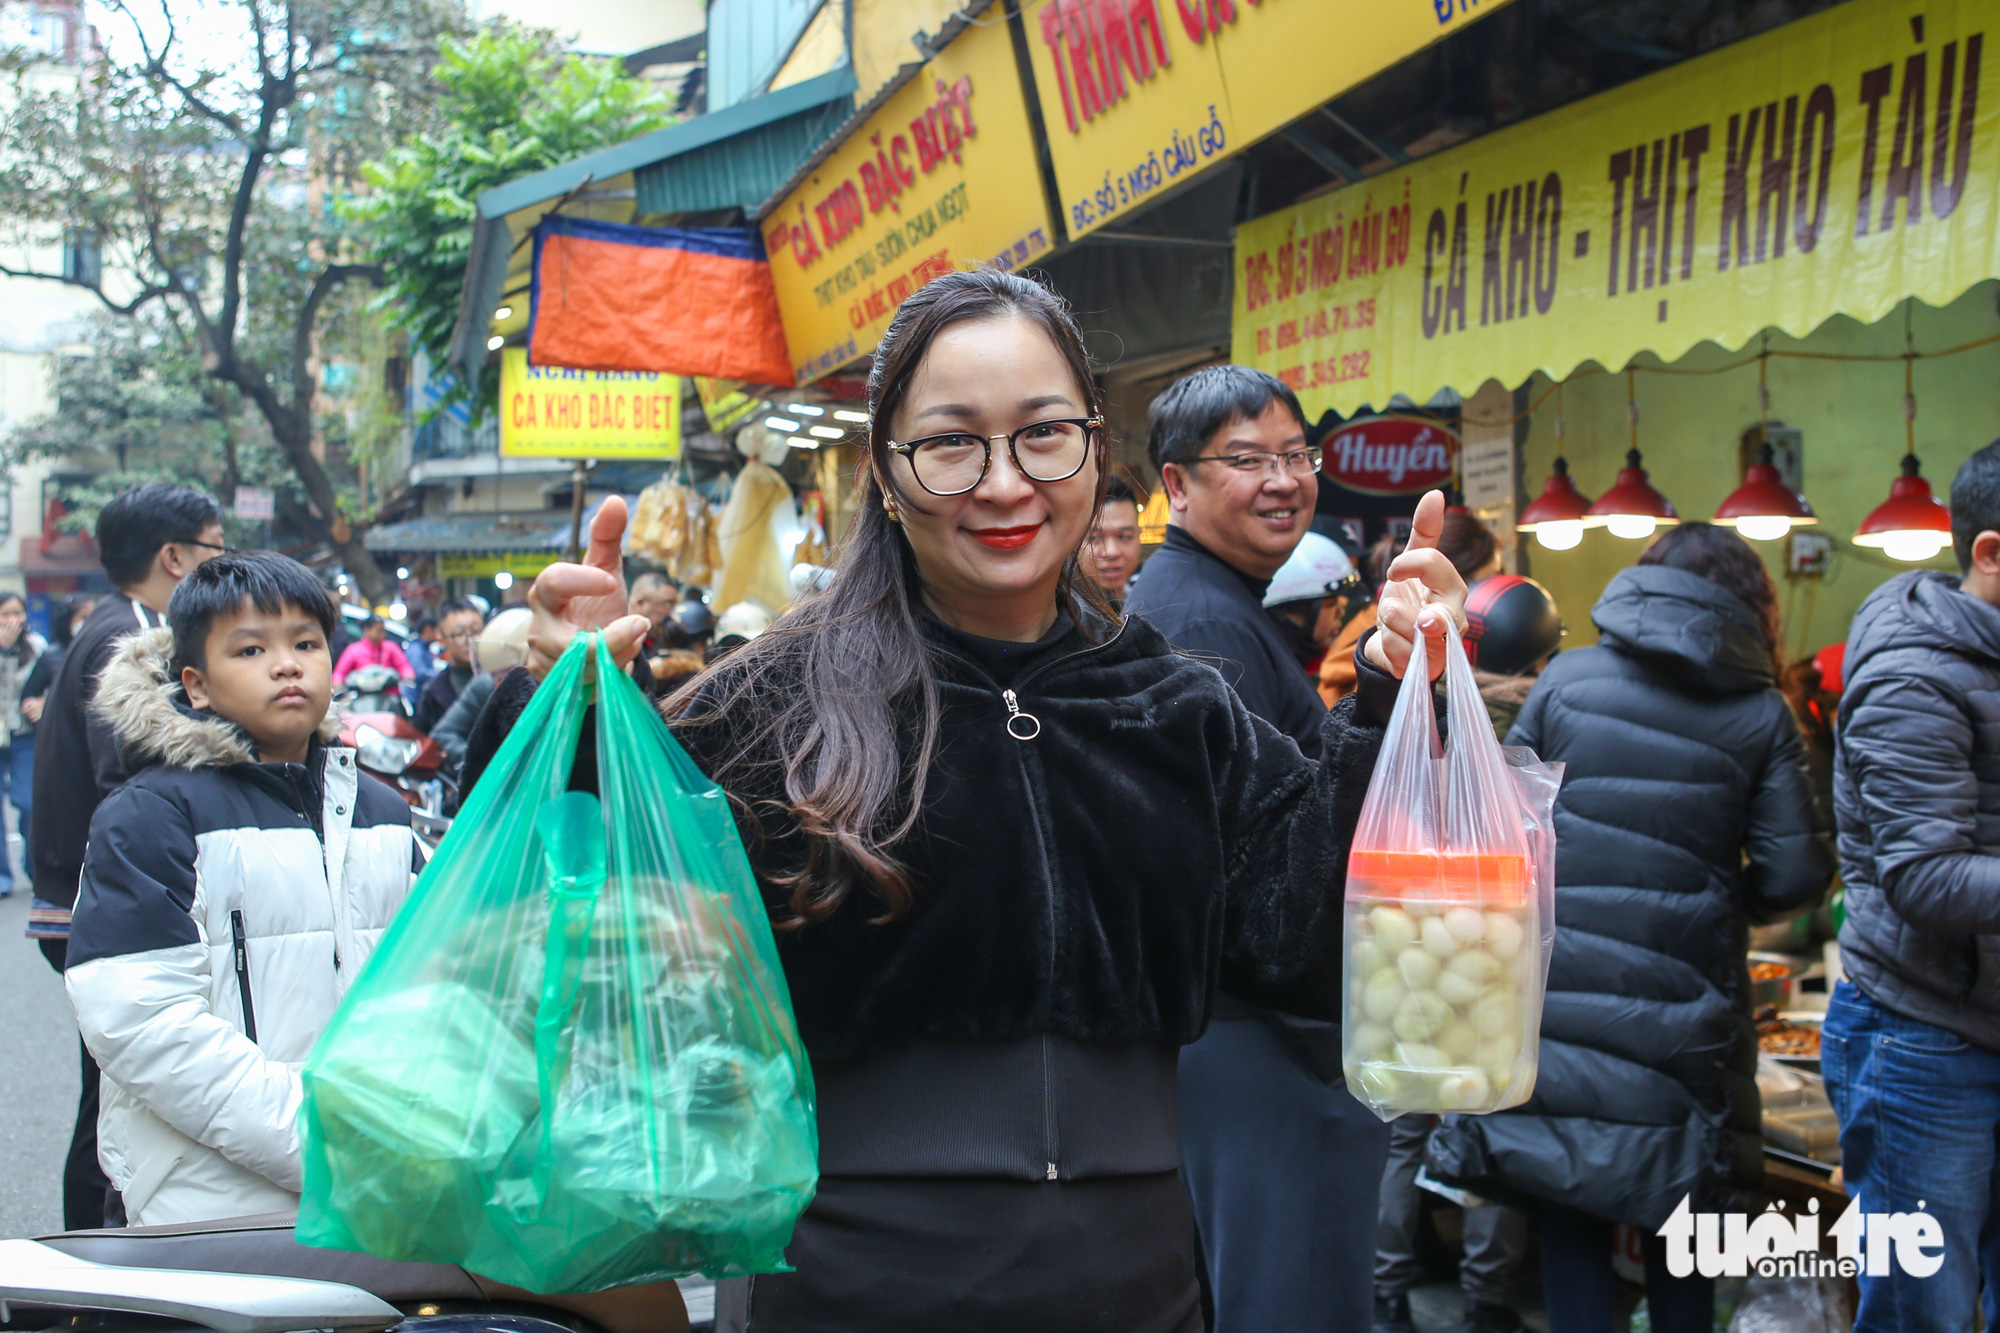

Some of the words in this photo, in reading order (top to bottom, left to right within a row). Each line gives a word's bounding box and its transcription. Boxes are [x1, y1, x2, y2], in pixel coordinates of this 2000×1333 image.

[791, 201, 821, 269] CÁ
[815, 179, 863, 250] KHO
[858, 129, 914, 213] ĐẶC
[909, 75, 976, 174] BIỆT
[1095, 170, 1116, 216] SỐ
[1118, 177, 1128, 204] 5
[1128, 150, 1162, 199] NGÕ
[1163, 128, 1196, 177] CẦU
[1198, 104, 1225, 157] GỖ
[1421, 171, 1469, 340] CÁ
[1480, 171, 1562, 327] KHO
[1608, 123, 1711, 323] THỊT
[1718, 83, 1836, 273] KHO
[1854, 14, 1985, 238] TÀU
[835, 264, 857, 295] KHO
[905, 206, 939, 246] CHUA
[934, 182, 970, 227] NGỌT
[1277, 218, 1297, 303] SỐ
[1296, 237, 1309, 295] 5
[1310, 212, 1344, 291] NGÕ
[1347, 192, 1382, 280] CẦU
[1384, 178, 1411, 269] GỖ
[512, 389, 537, 429] CÁ
[544, 392, 582, 429] KHO
[589, 388, 625, 437] ĐẶC
[633, 387, 673, 438] BIỆT
[1333, 426, 1452, 484] Huyền
